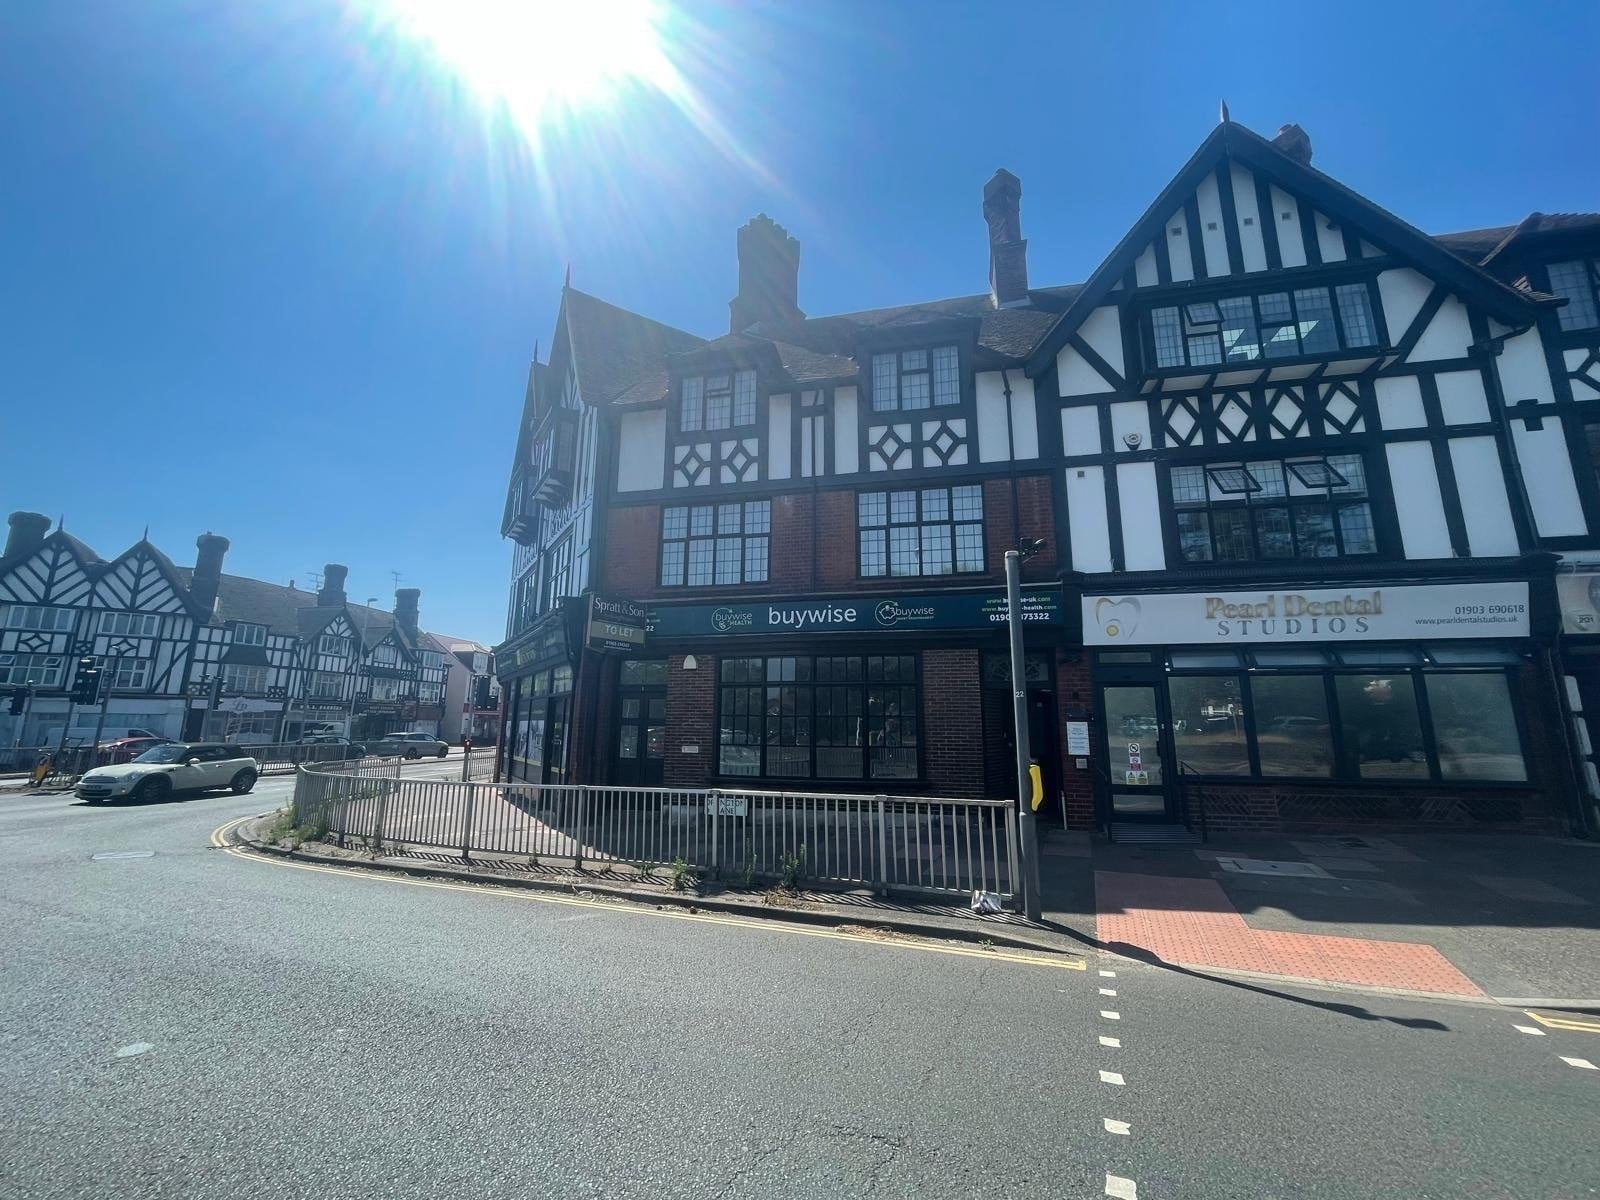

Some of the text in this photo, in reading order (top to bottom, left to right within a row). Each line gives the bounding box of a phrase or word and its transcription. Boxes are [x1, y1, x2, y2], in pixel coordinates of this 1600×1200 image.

[593, 598, 620, 613] Spratt
[629, 604, 645, 618] Son
[895, 606, 935, 616] buywise
[1205, 590, 1383, 619] Pearl Dental
[1455, 604, 1525, 615] 01903 690618
[715, 611, 753, 623] buywise
[768, 604, 857, 628] buywise
[1415, 615, 1519, 626] www.pearldentalstudios.uk
[605, 624, 634, 637] TO LET
[1217, 617, 1370, 636] STUDIOS
